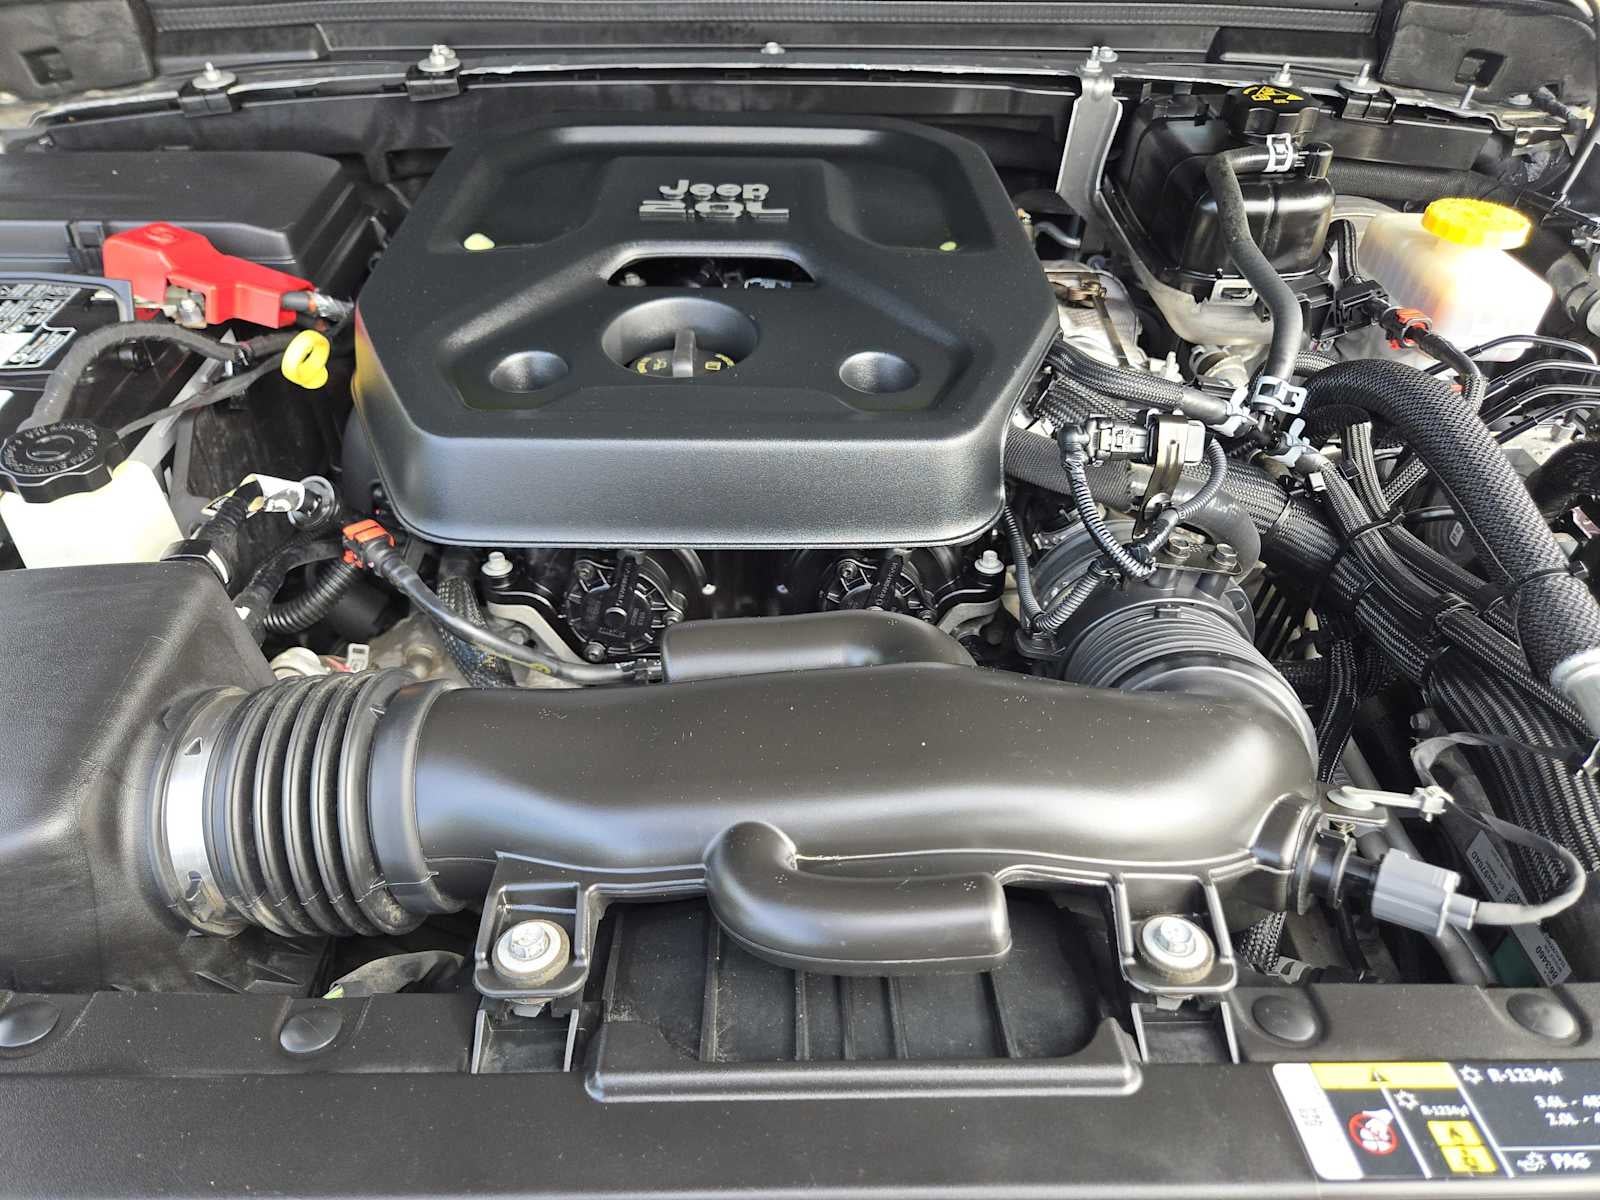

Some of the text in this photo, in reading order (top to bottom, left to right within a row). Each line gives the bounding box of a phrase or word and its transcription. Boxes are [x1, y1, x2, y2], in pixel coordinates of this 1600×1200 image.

[659, 179, 770, 201] Jeep
[639, 200, 790, 218] 2.0L
[1550, 1152, 1592, 1170] PAG
